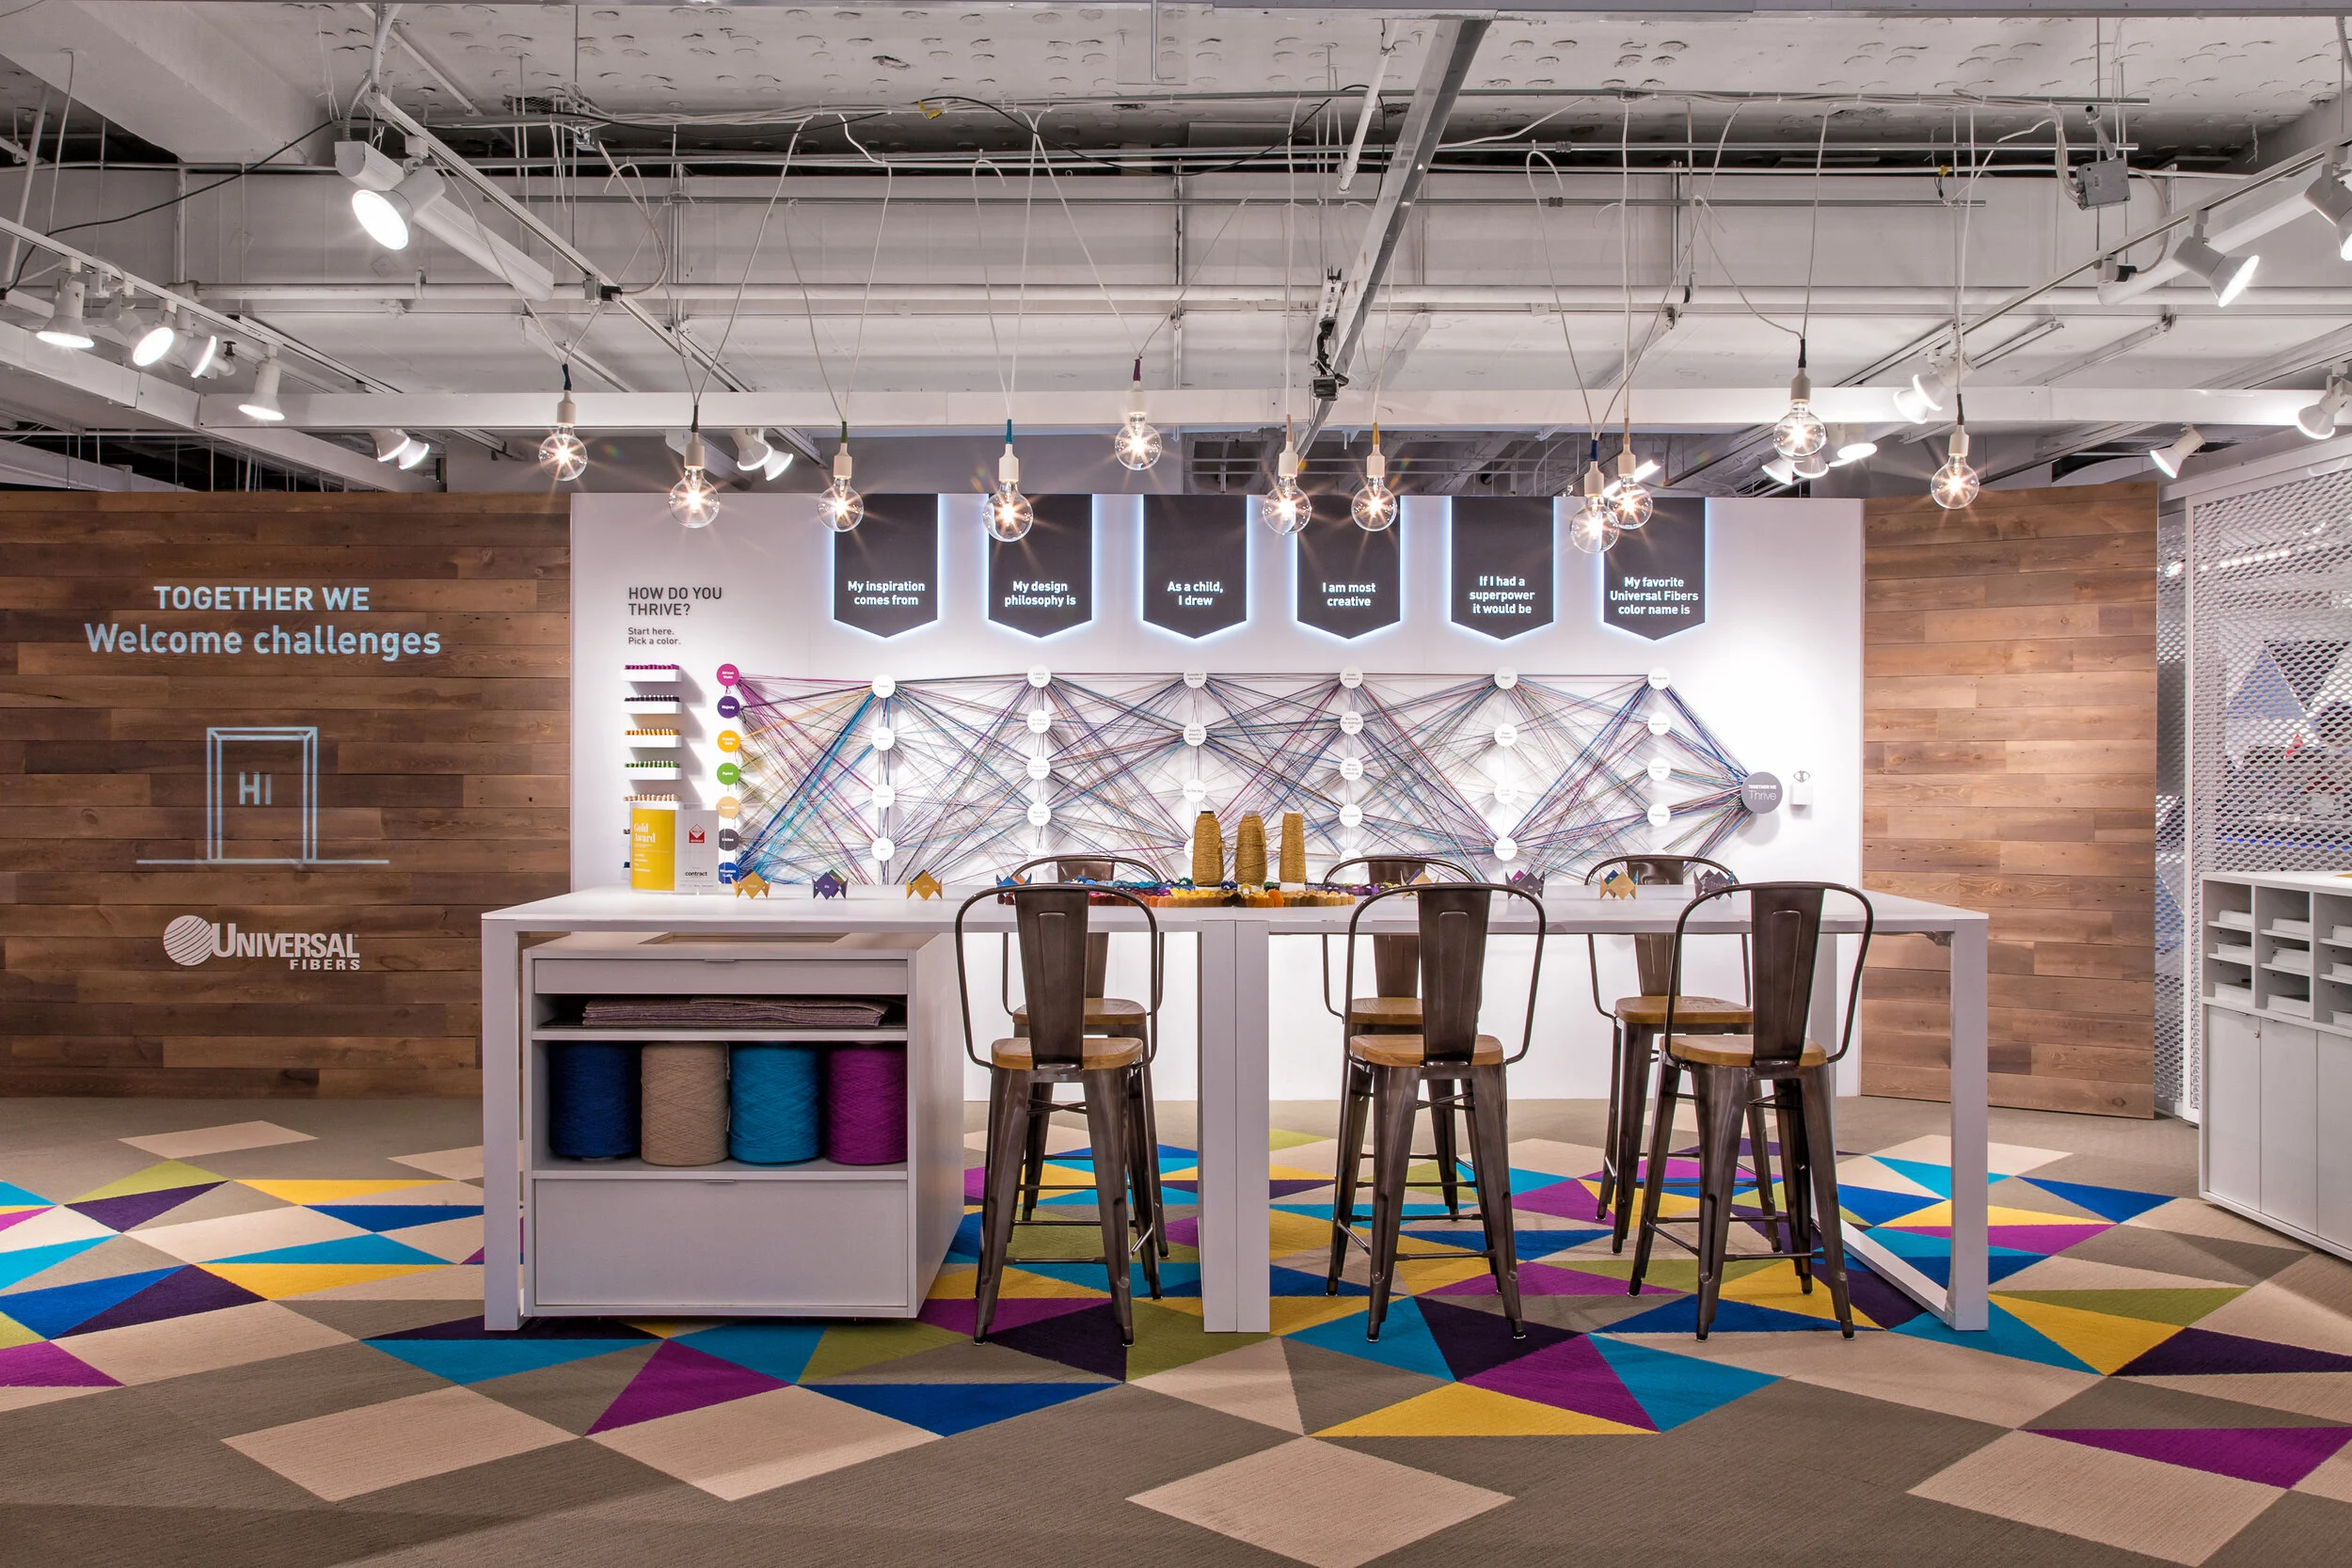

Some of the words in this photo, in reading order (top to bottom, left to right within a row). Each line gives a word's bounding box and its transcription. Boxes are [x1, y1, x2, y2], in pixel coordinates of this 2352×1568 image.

[848, 580, 865, 594] My
[866, 580, 926, 594] inspiration
[1012, 580, 1030, 594] My
[1030, 580, 1068, 594] design
[1167, 580, 1183, 593] As
[1184, 583, 1191, 592] a
[1192, 580, 1224, 594] child,
[1479, 575, 1488, 587] If
[1489, 577, 1494, 587] I
[1496, 576, 1517, 587] had
[1518, 578, 1526, 587] a
[1624, 576, 1641, 590] My
[1642, 577, 1685, 588] favorite
[628, 586, 664, 600] HOW
[668, 587, 689, 600] DO
[691, 587, 723, 600] YOU
[1322, 582, 1327, 593] I
[1327, 584, 1346, 594] am
[1348, 582, 1376, 593] most
[153, 586, 313, 610] TOGETHER
[322, 587, 369, 610] WE
[853, 596, 890, 606] comes
[891, 594, 919, 606] from
[1004, 594, 1065, 609] philosophy
[1066, 594, 1076, 606] is
[1178, 595, 1183, 606] I
[1184, 594, 1214, 606] drew
[1327, 595, 1372, 607] creative
[1469, 592, 1535, 605] superpower
[1610, 590, 1662, 601] Universal
[1663, 590, 1699, 601] Fibers
[628, 603, 691, 616] THRIVE?
[1472, 603, 1482, 614] it
[1482, 603, 1517, 614] would
[1518, 603, 1533, 614] be
[1617, 604, 1646, 615] color
[1647, 606, 1678, 615] name
[1680, 604, 1691, 615] is
[628, 626, 650, 636] Start
[652, 626, 675, 636] here.
[85, 624, 242, 654] Welcome
[254, 626, 440, 661] challenges
[628, 636, 647, 645] Pick
[656, 637, 682, 645] color.
[240, 772, 271, 804] HI
[1749, 790, 1776, 800] Thrive
[634, 823, 649, 833] Gold
[212, 923, 360, 958] UNIVERSAL
[291, 959, 359, 970] FIBERS
